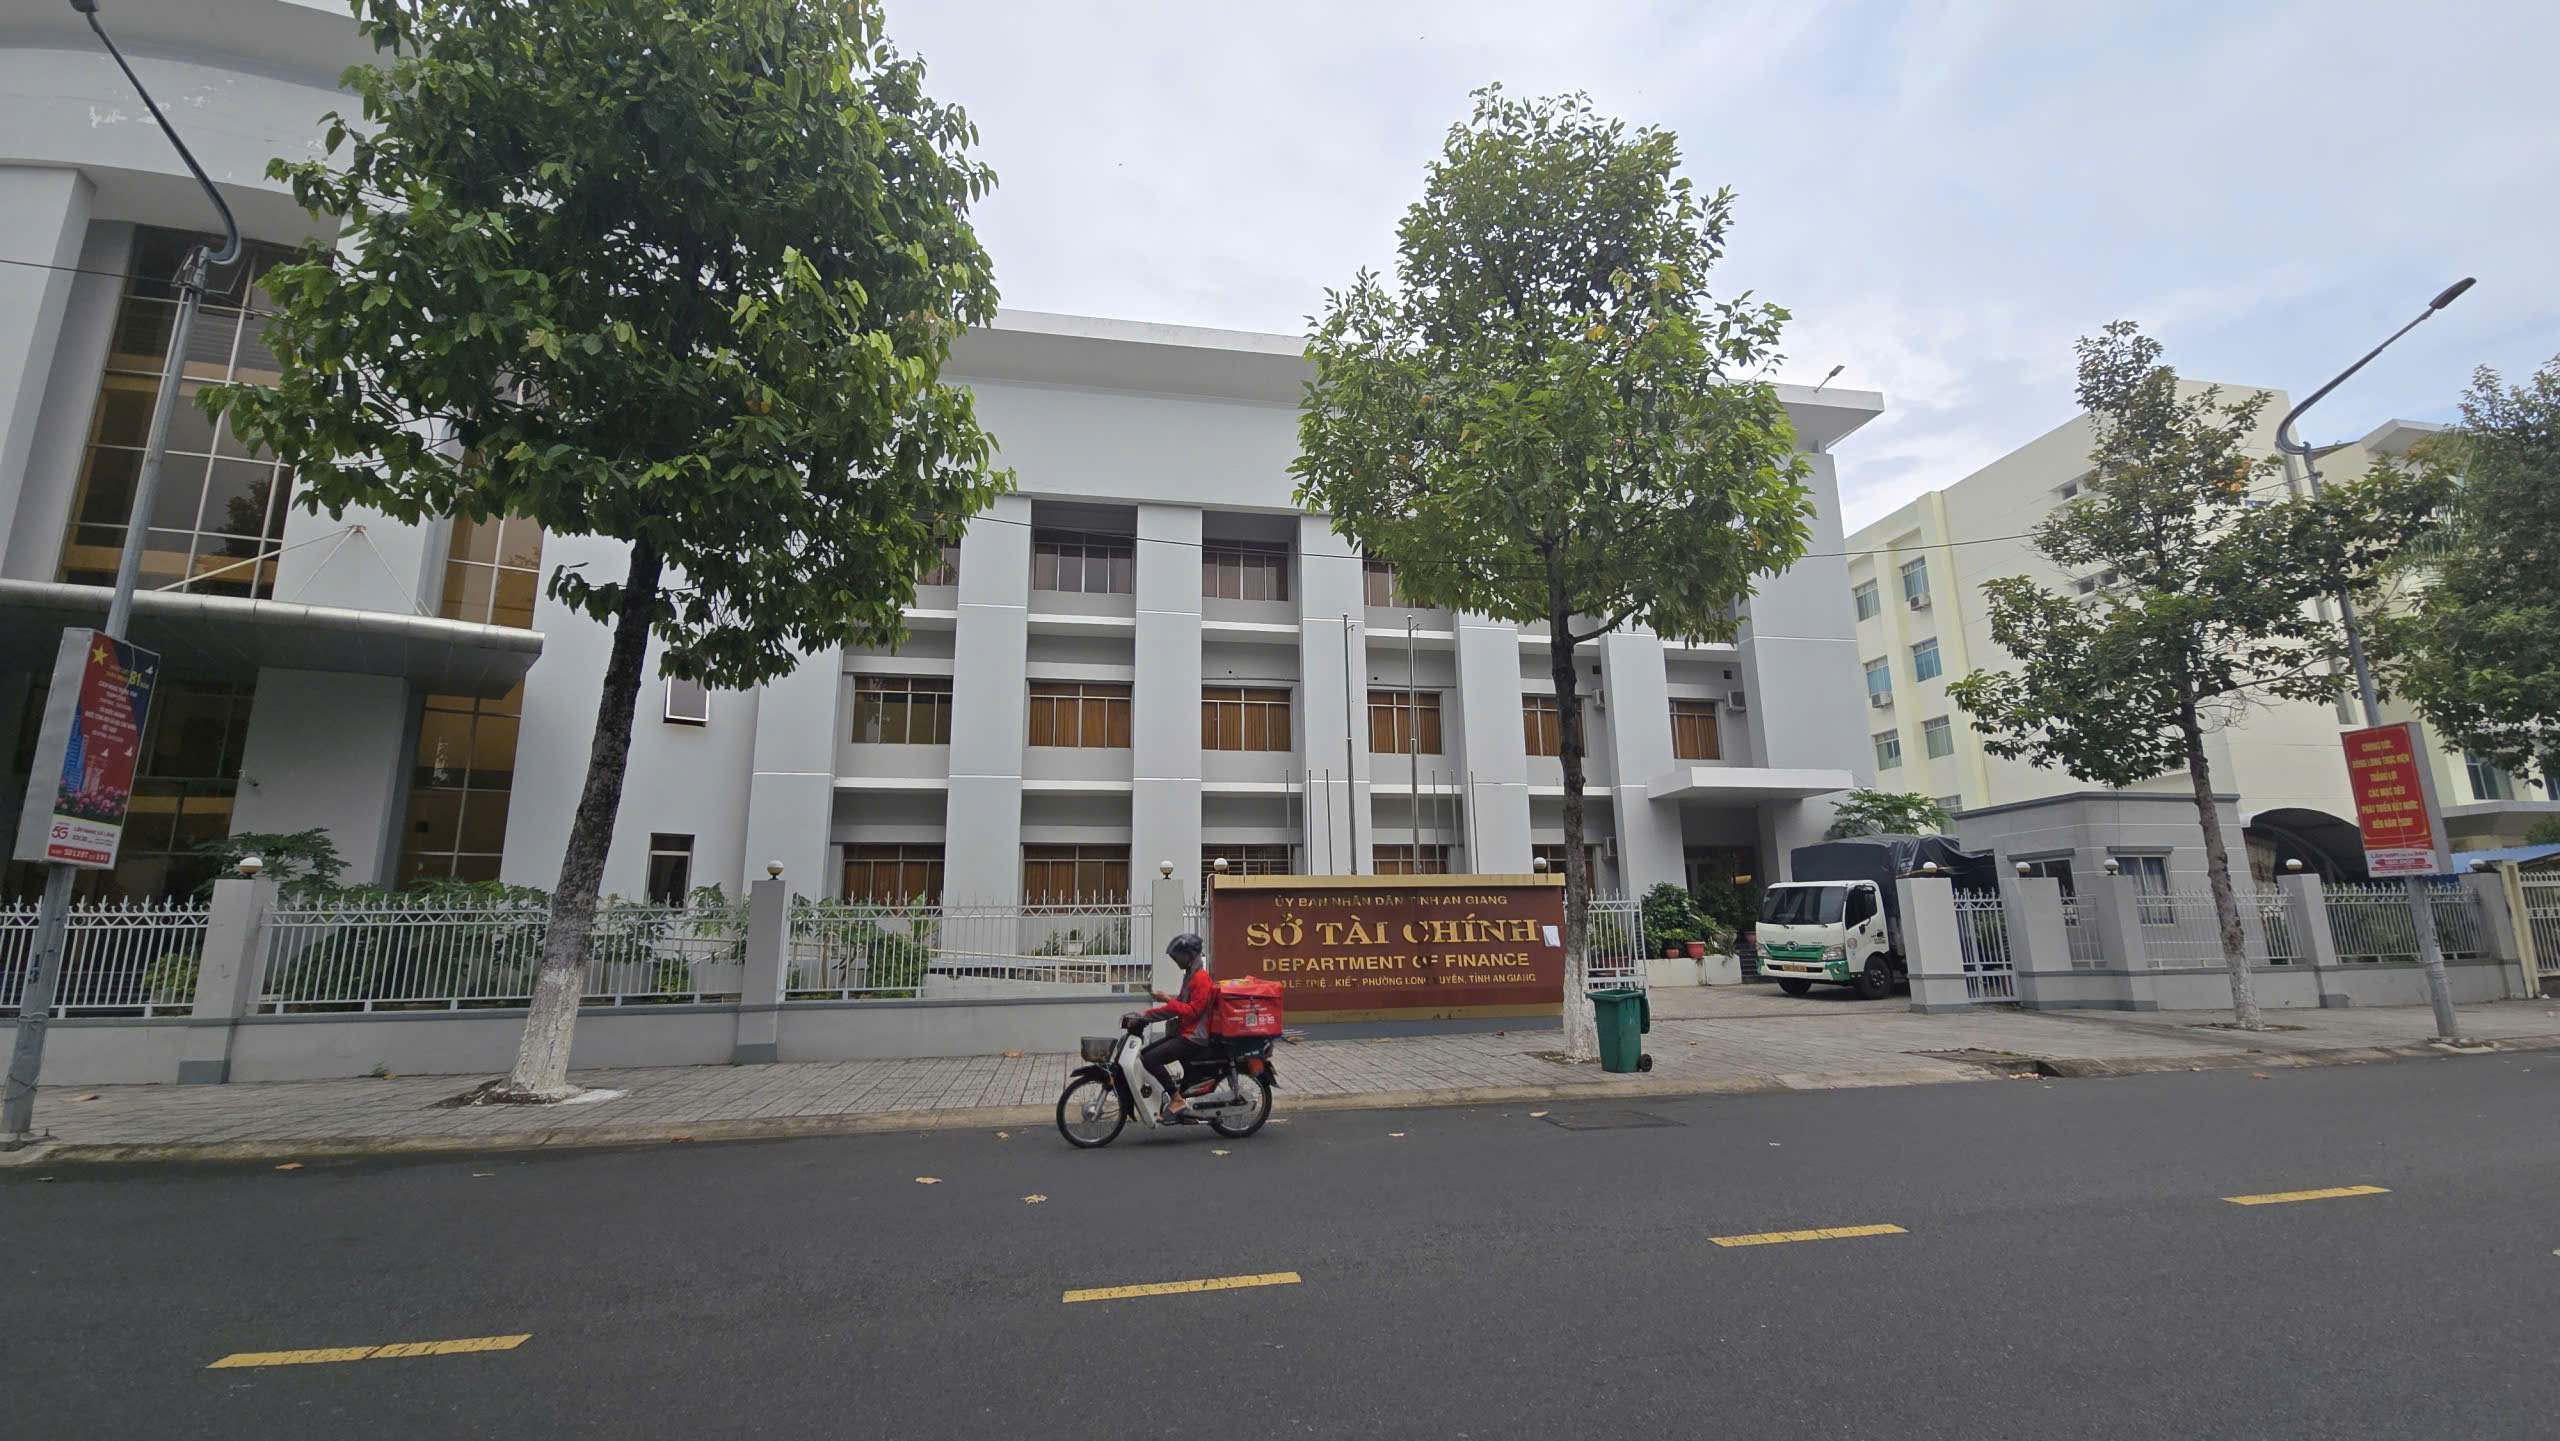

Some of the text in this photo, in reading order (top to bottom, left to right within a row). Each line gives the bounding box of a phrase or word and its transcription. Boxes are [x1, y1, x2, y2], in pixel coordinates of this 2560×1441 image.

[51, 826, 70, 840] 5G
[1298, 896, 1328, 907] BAN
[1332, 894, 1371, 907] NHÂN
[1375, 894, 1403, 906] DÂN
[1442, 895, 1461, 905] AN
[1465, 895, 1508, 906] GIANG
[1246, 912, 1540, 947] SỞ TÀI CHÍNH
[1263, 955, 1406, 972] DEPARTMENT
[1445, 953, 1530, 968] FINANCE
[1362, 975, 1403, 987] PHƯỜNG
[1492, 974, 1505, 983] AN
[1506, 973, 1536, 983] GIANG
